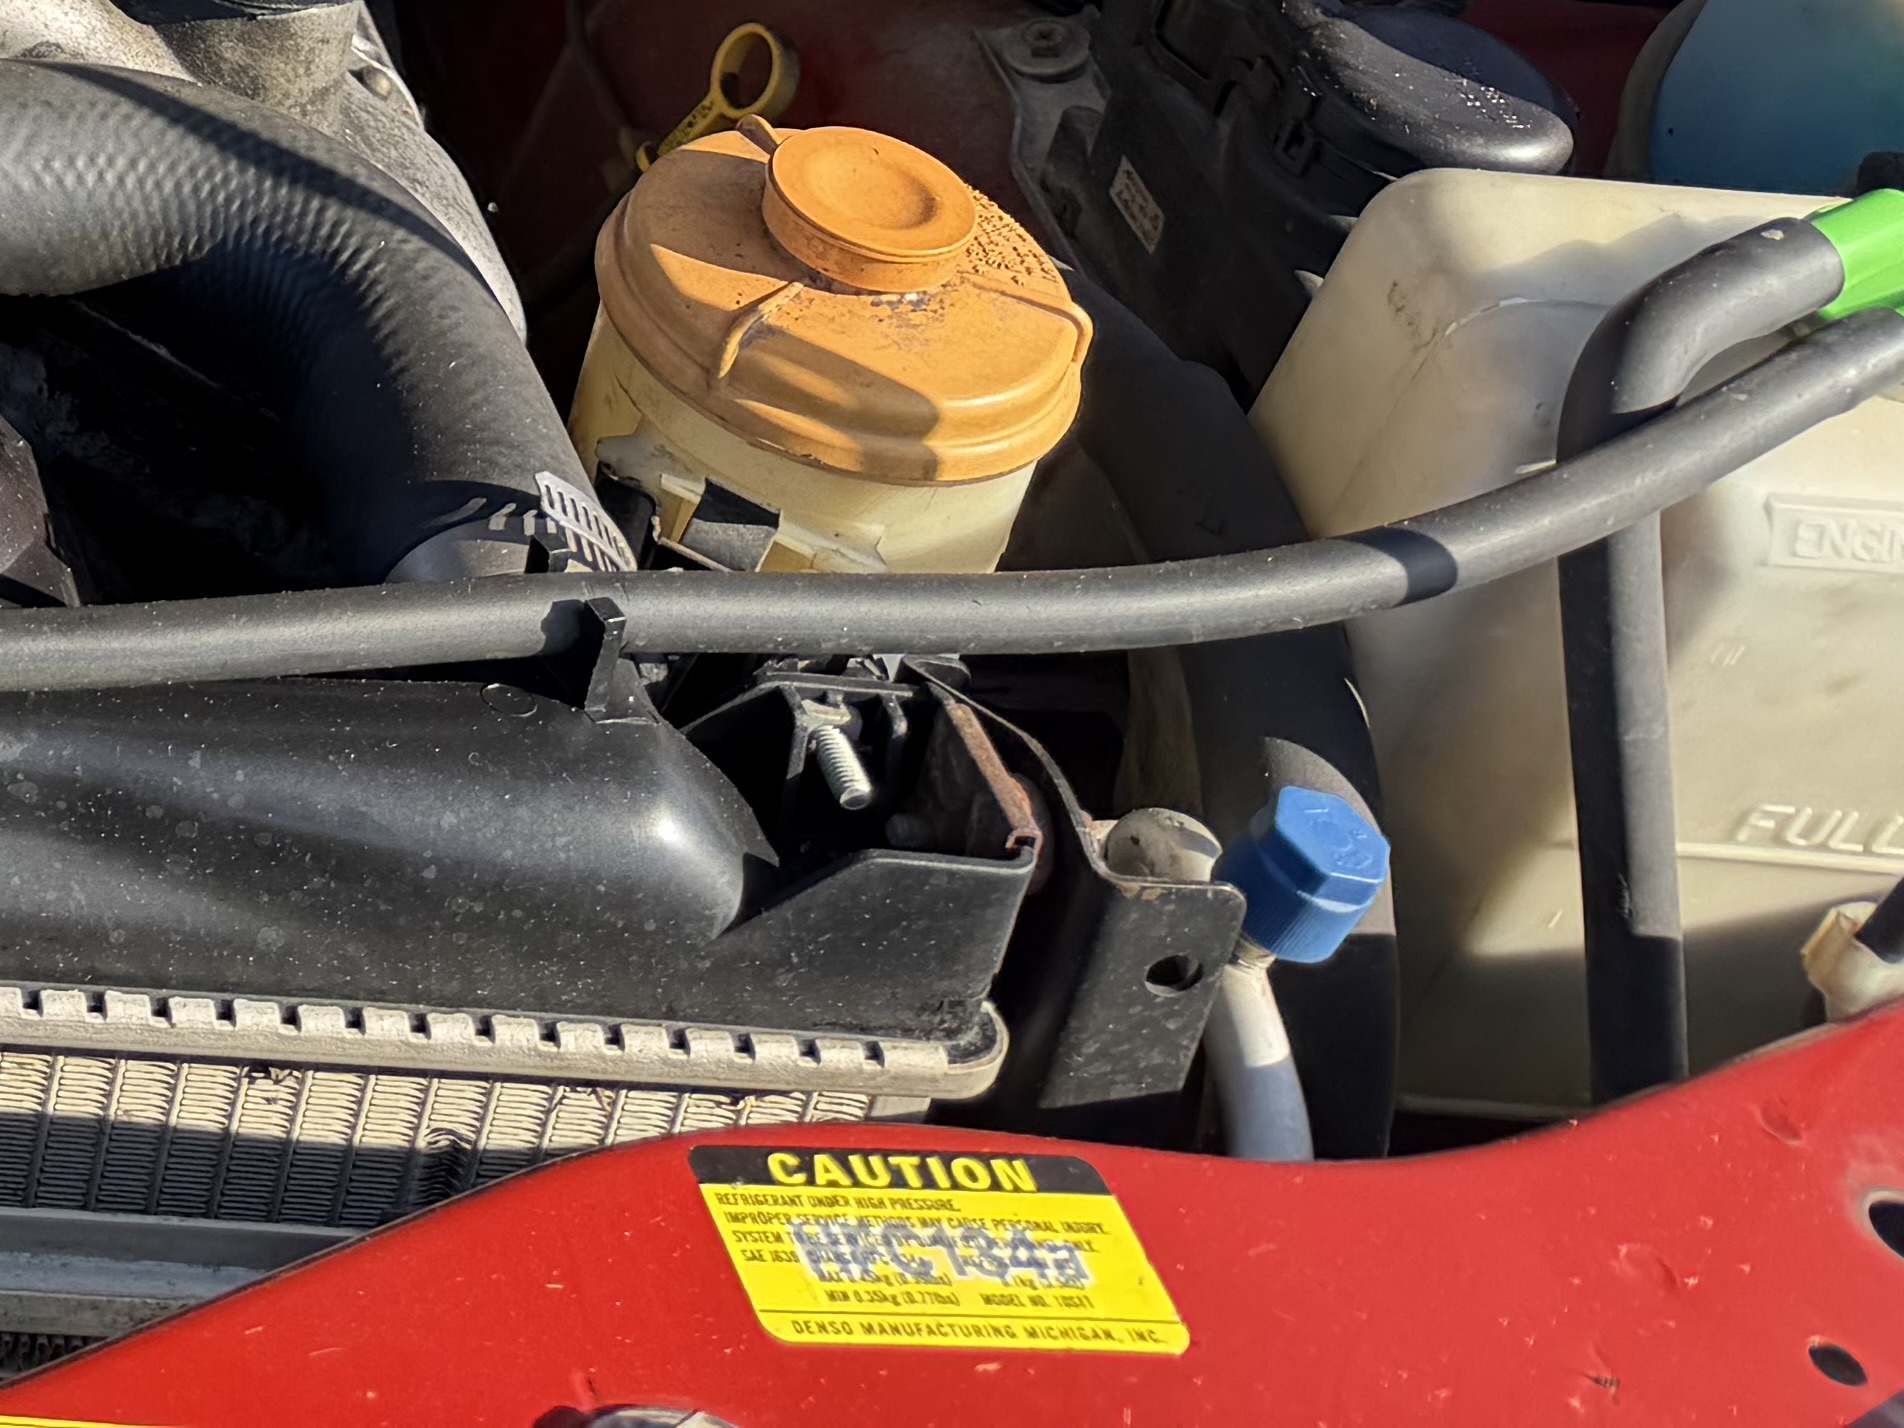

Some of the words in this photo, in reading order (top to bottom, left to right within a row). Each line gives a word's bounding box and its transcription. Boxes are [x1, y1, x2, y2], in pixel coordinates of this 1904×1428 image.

[1735, 803, 1904, 855] FULL
[767, 1152, 1039, 1193] CAUTION
[715, 1192, 806, 1208] REFRIGERANT
[808, 1195, 854, 1209] UNDER
[856, 1196, 887, 1210] HIGH
[890, 1197, 961, 1213] PRESSURE.
[724, 1211, 792, 1226] IMPROPER
[795, 1213, 849, 1227] SERVICE
[855, 1215, 916, 1229] METHODS
[917, 1217, 942, 1230] MAY
[947, 1217, 988, 1231] CAUSE
[991, 1218, 1059, 1235] PERSONAL
[733, 1230, 784, 1244] SYSTEM
[741, 1249, 769, 1263] SAE
[824, 1290, 850, 1302] MIN
[980, 1293, 1025, 1307] MODEL
[791, 1320, 854, 1335] DENSO
[860, 1321, 1018, 1340] MANUFACTURING
[1024, 1325, 1126, 1343] MICHIGAN,
[1129, 1329, 1170, 1345] INC.
